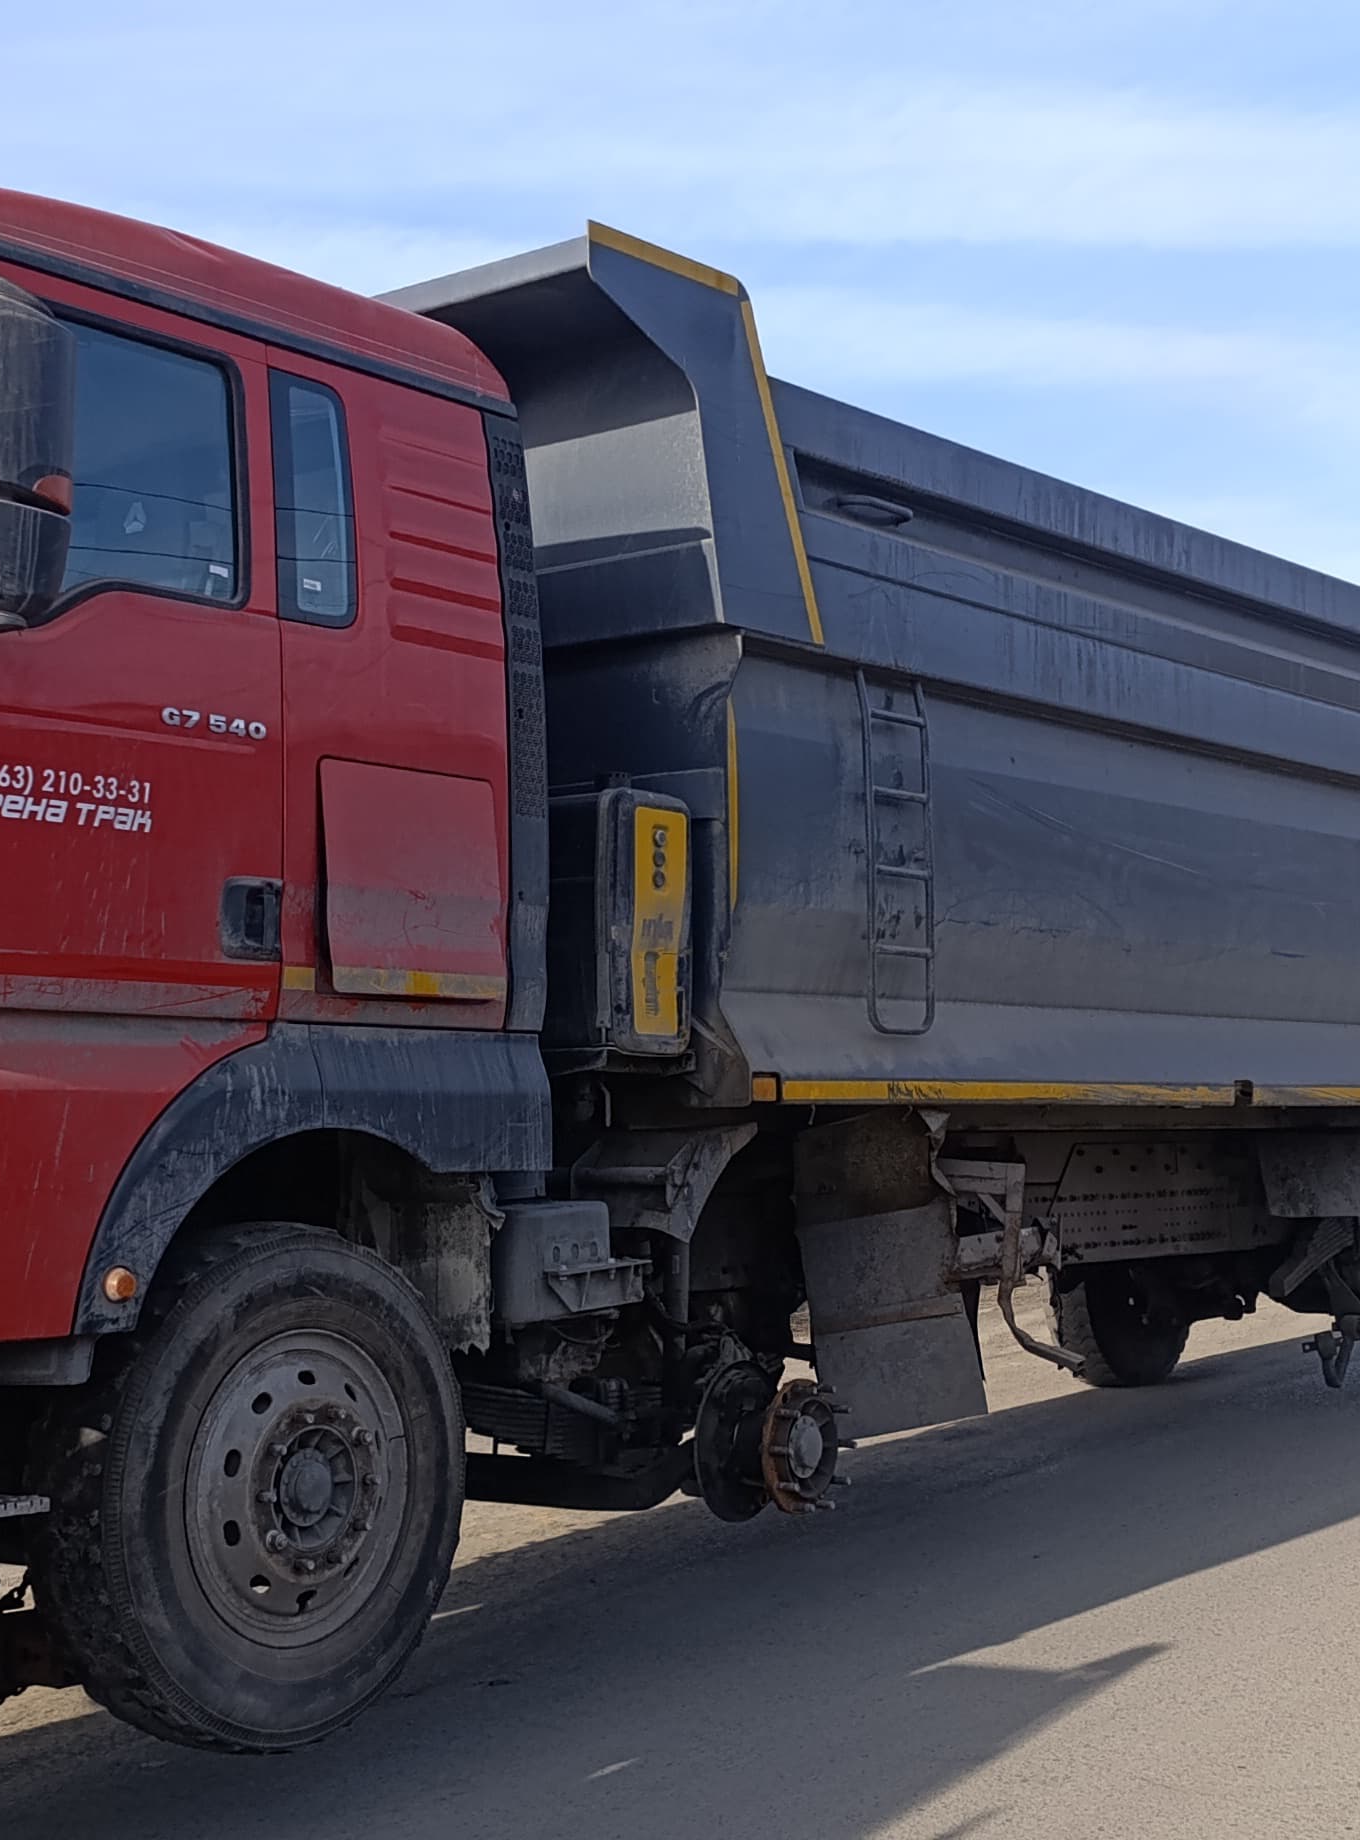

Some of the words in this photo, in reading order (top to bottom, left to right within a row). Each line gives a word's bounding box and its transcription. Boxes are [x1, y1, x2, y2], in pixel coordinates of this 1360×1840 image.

[161, 707, 200, 728] G7
[208, 713, 267, 740] 540
[42, 769, 152, 804] 210-33-31
